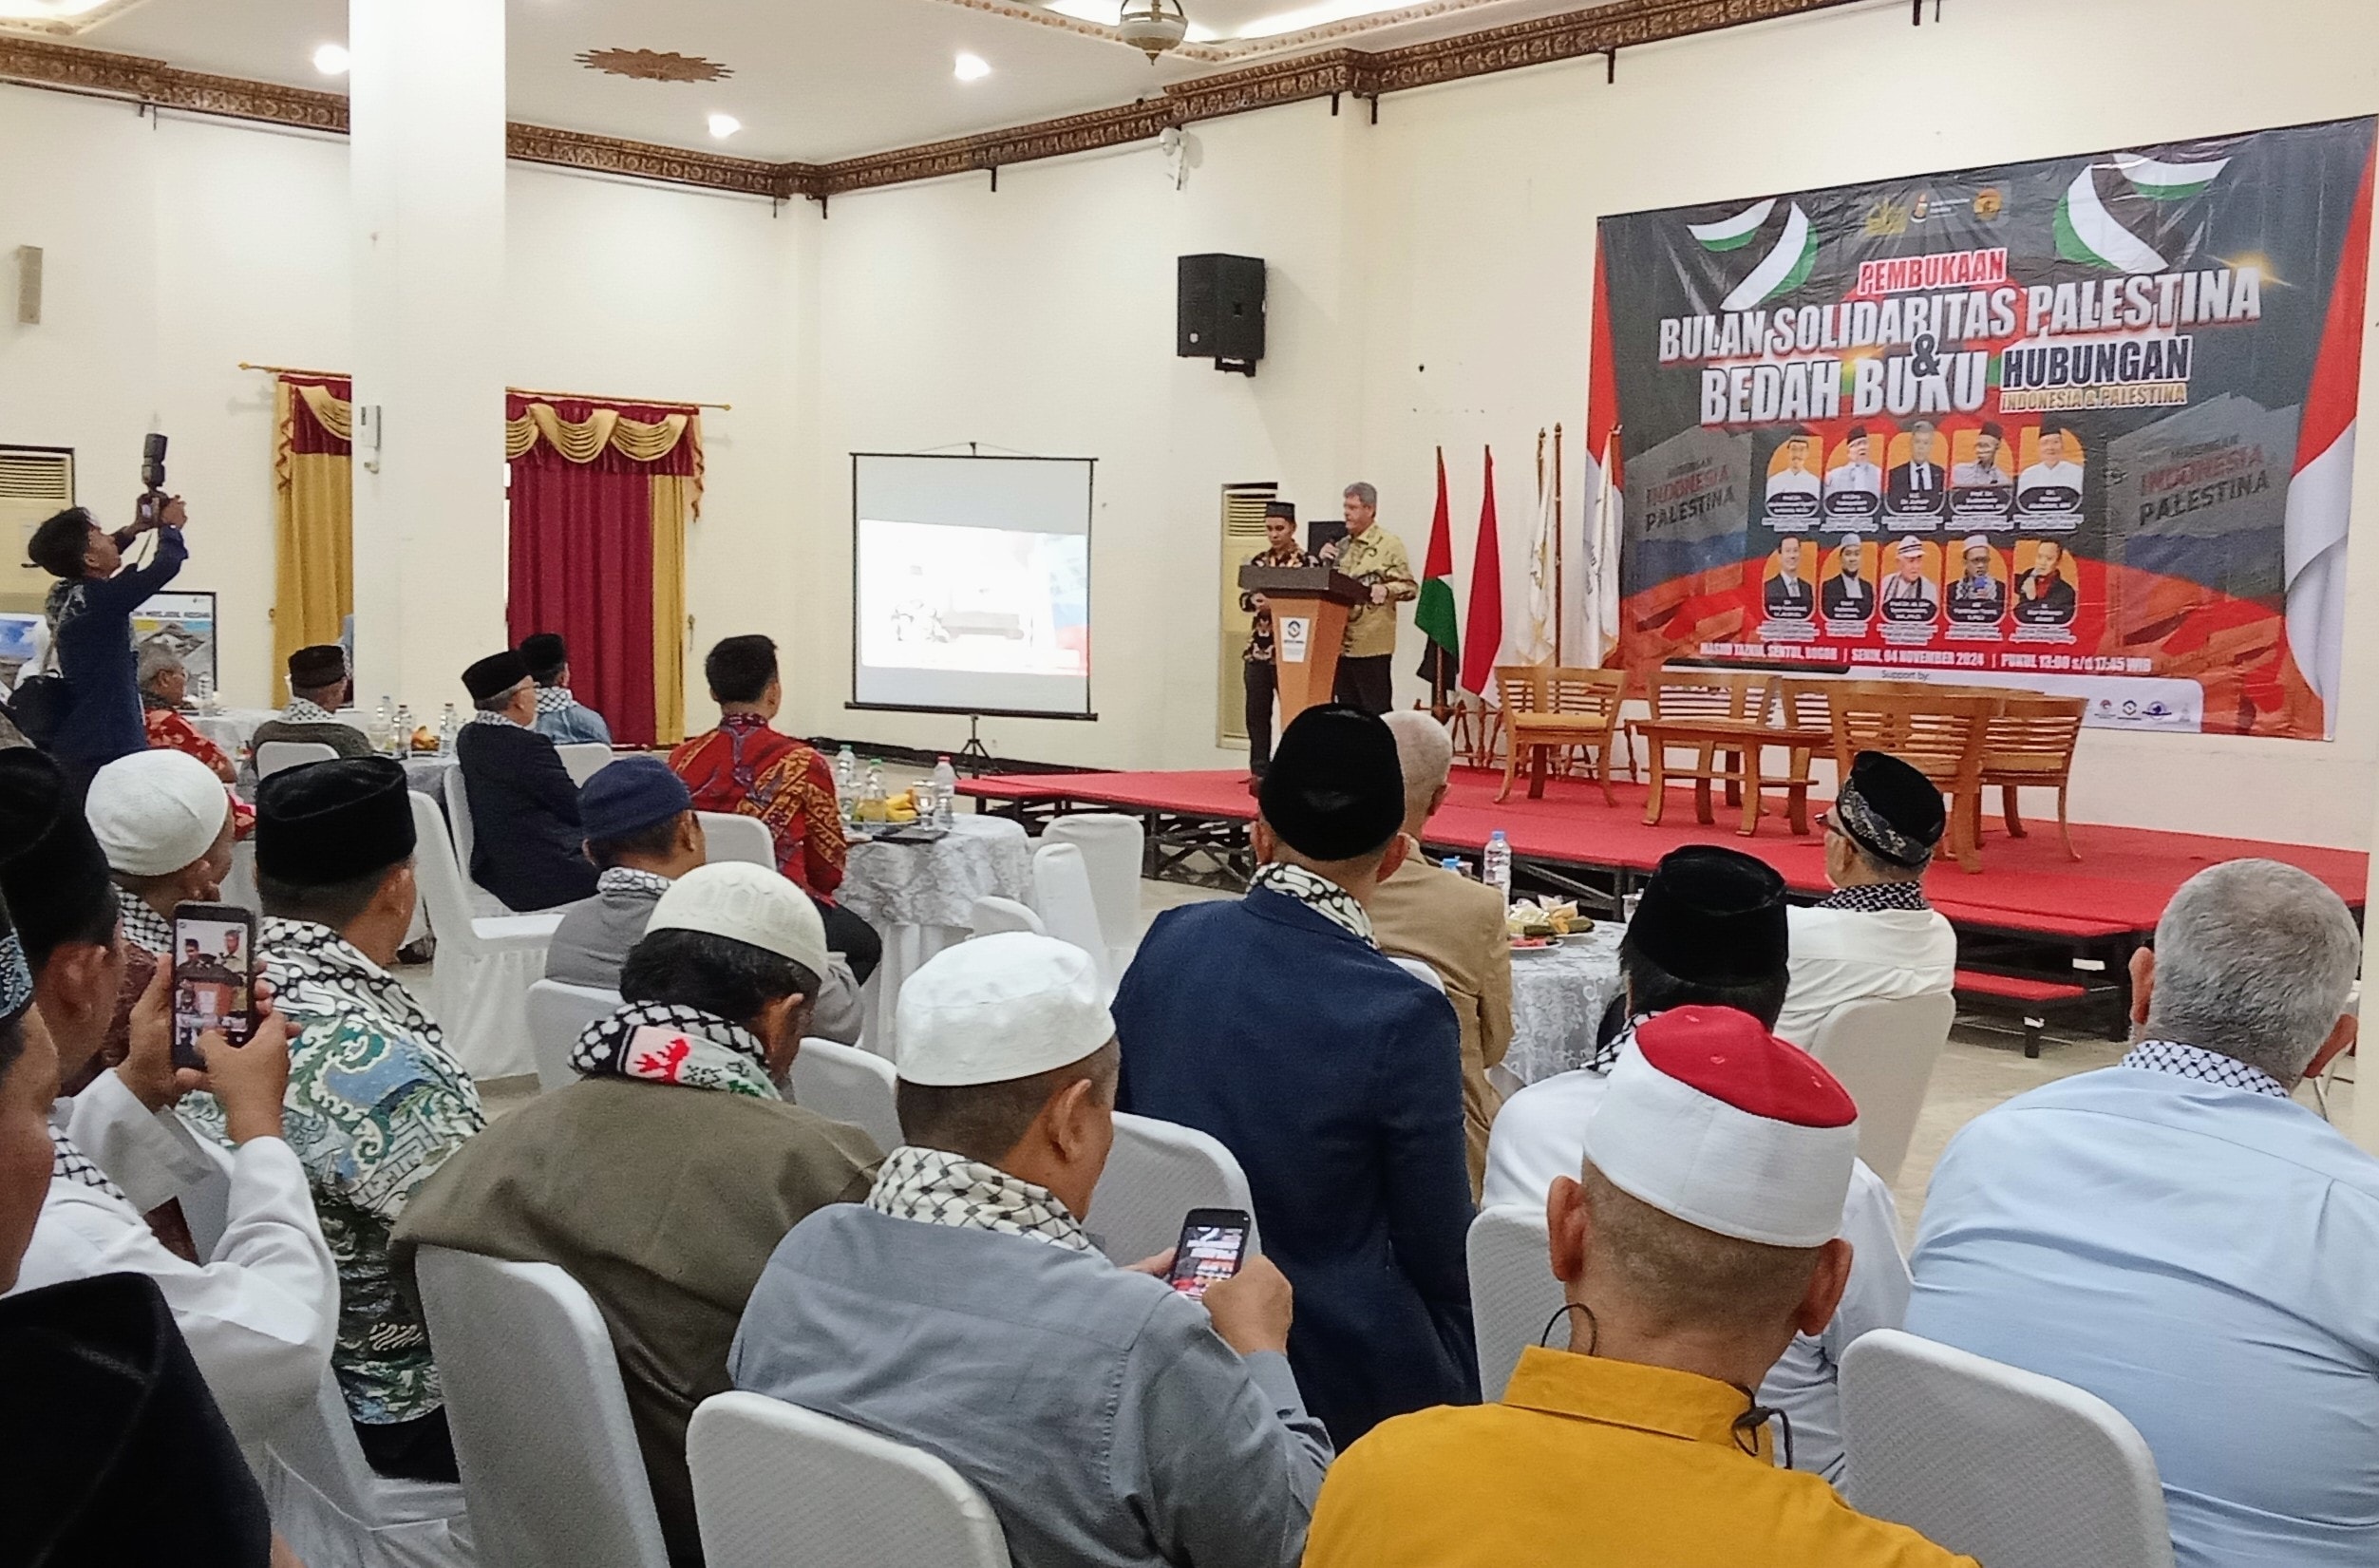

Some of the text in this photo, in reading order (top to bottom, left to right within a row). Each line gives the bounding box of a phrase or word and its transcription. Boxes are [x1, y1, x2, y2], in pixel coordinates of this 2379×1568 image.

[1858, 250, 2007, 293] PEMBUKAAN
[1659, 267, 2260, 364] BULAN SOLIDARITAS PALESTINA
[1910, 333, 1940, 378] &
[2003, 337, 2190, 388] HUBUNGAN
[1701, 351, 1989, 425] BEDAH BUKU
[2001, 383, 2187, 411] INDONESIA & PALESTINA
[1645, 484, 1736, 533] PALESTINA
[2139, 469, 2270, 526] PALESTINA
[1881, 670, 1916, 679] Support
